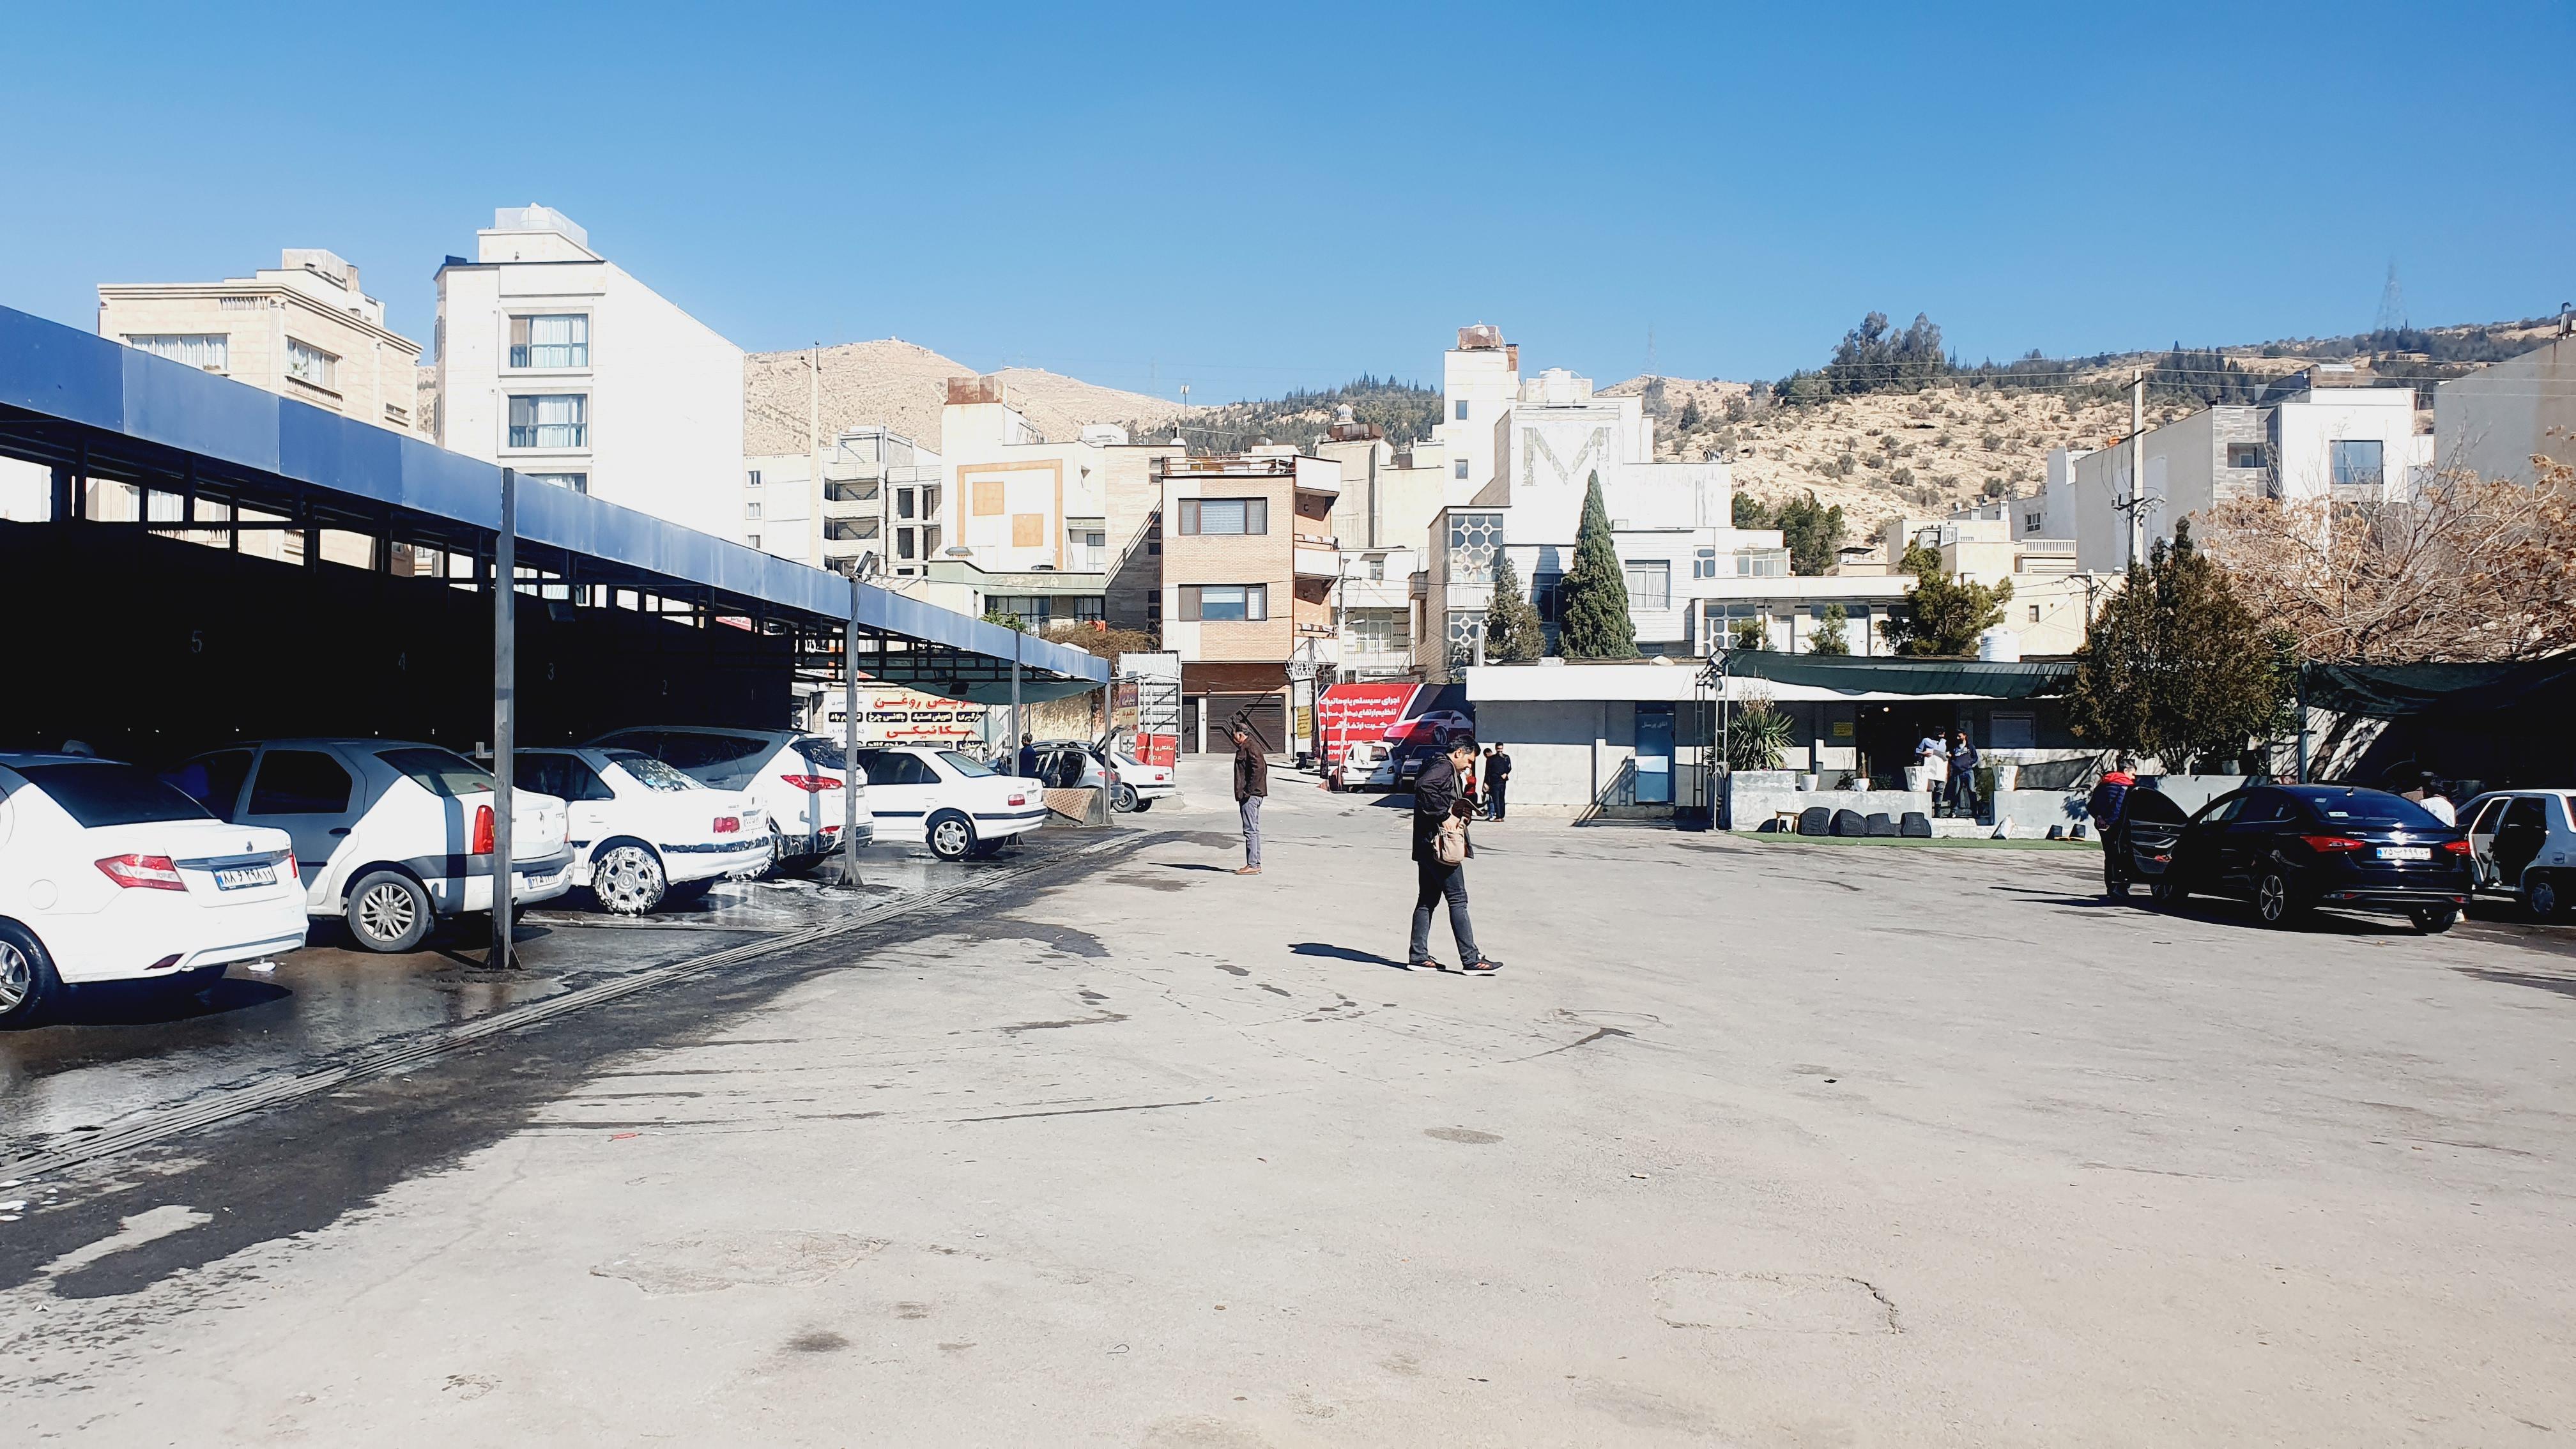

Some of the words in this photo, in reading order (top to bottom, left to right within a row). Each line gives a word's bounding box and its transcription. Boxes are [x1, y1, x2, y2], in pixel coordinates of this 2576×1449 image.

[1521, 427, 1612, 486] M
[190, 629, 204, 655] 5
[397, 651, 408, 671] 4
[546, 663, 555, 680] 3
[662, 680, 669, 696] 2
[873, 693, 921, 710] روغن
[1353, 697, 1381, 706] سیستم
[1381, 696, 1400, 706] اجرای
[868, 712, 882, 722] چرخ
[883, 713, 906, 721] بالانس
[1358, 709, 1376, 718] ارتفاع
[1376, 709, 1397, 717] تنظیم
[1365, 721, 1388, 730] کیت
